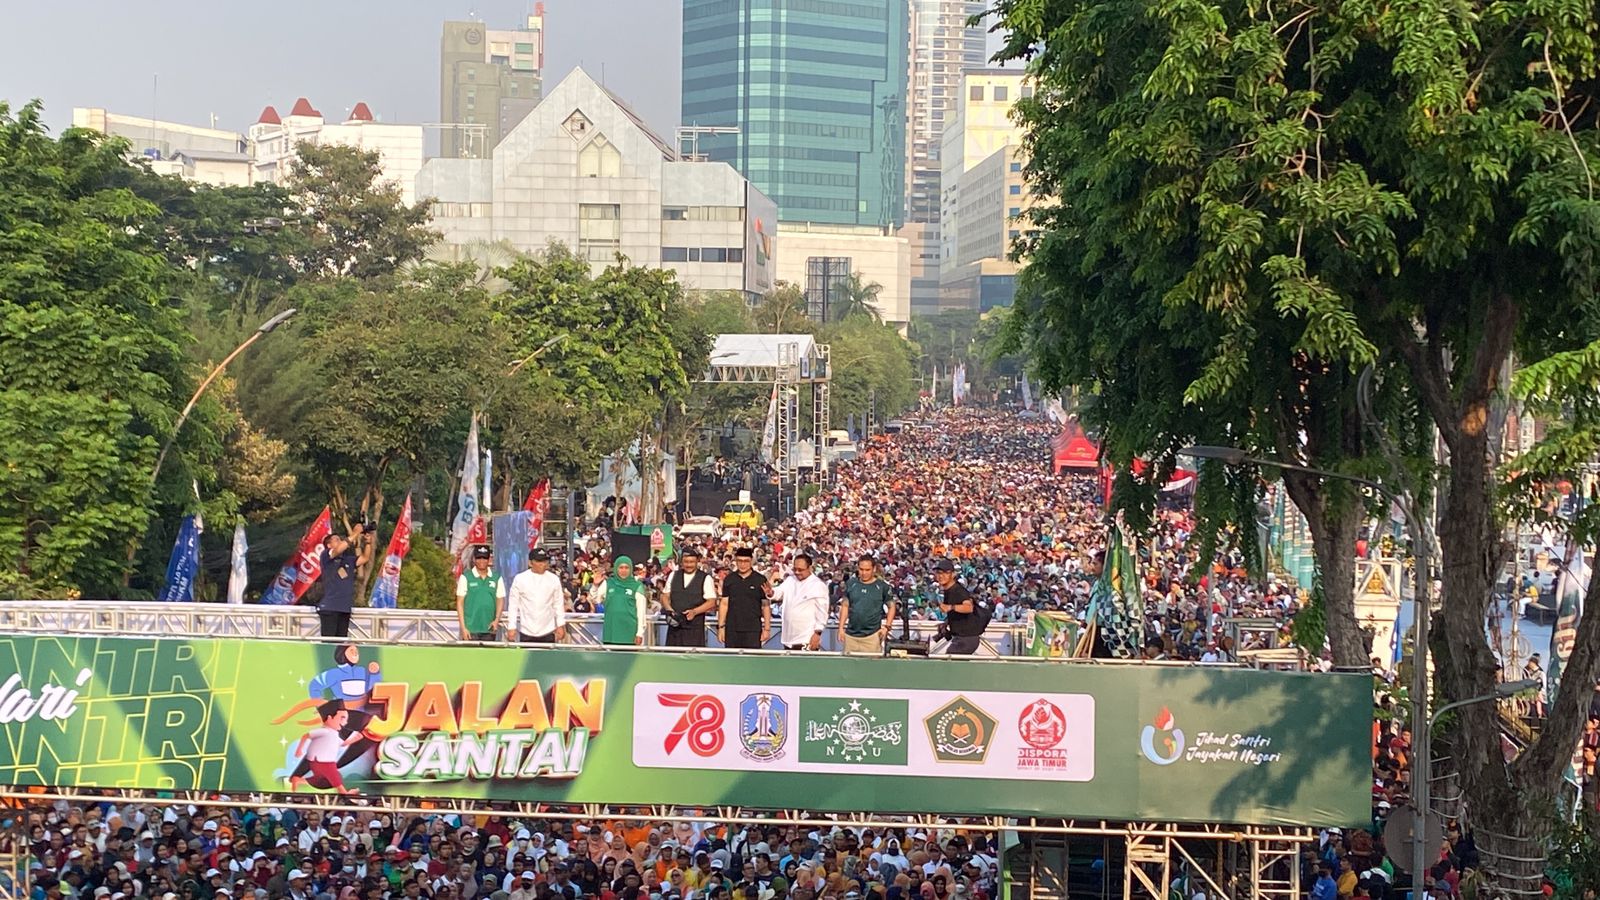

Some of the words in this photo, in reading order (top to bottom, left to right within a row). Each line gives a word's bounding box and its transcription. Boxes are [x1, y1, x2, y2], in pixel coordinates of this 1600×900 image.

[365, 679, 607, 739] JALAN
[657, 693, 726, 758] 78
[1195, 732, 1229, 746] Jihad
[1230, 733, 1272, 748] Santri
[376, 728, 592, 782] SANTAI
[826, 746, 835, 756] N
[872, 747, 882, 757] U
[1017, 749, 1067, 758] DISPORA
[1185, 747, 1237, 763] Jayakan
[1240, 749, 1281, 765] Negeri
[1017, 759, 1039, 767] JAWA
[1042, 759, 1067, 768] TIMUR
